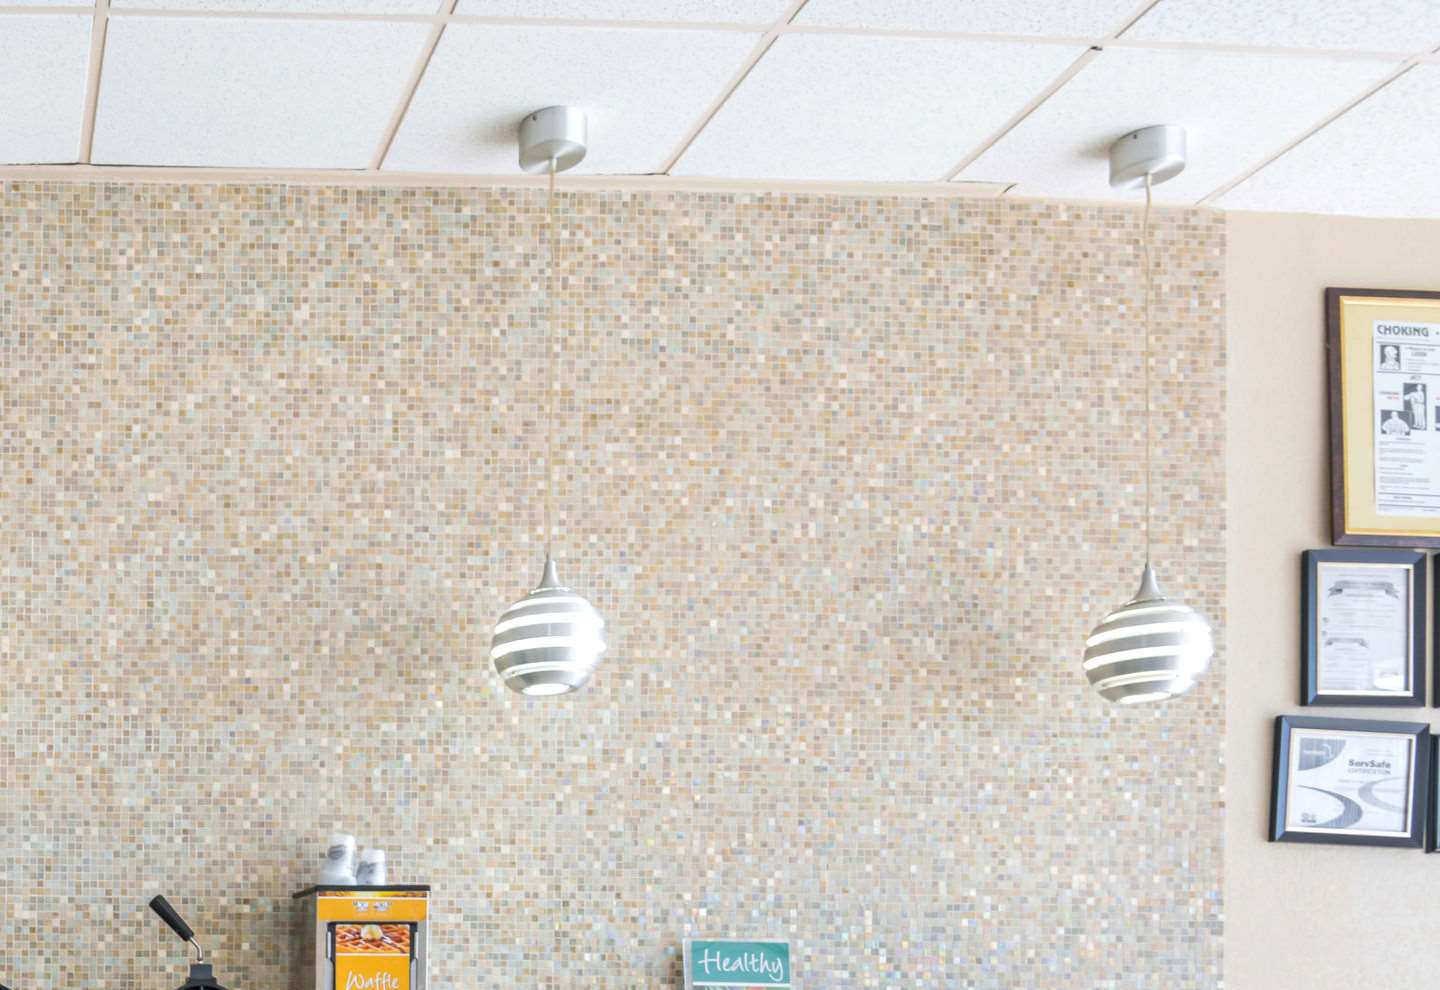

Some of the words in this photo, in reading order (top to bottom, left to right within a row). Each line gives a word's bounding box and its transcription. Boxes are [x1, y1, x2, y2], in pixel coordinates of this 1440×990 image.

[1376, 324, 1429, 337] CHOKING
[1348, 759, 1391, 769] ServSafe
[697, 948, 784, 982] Healthy
